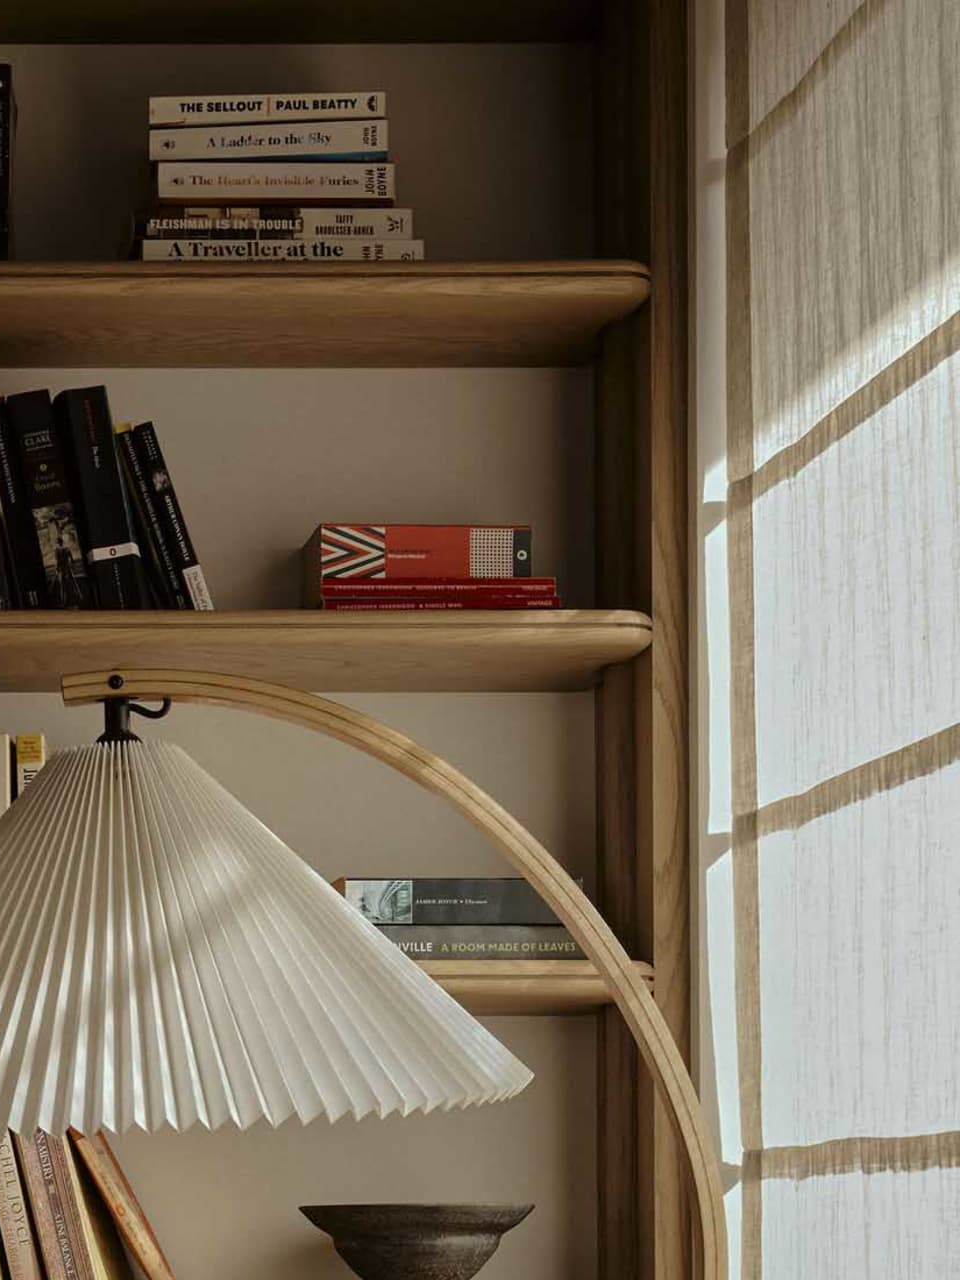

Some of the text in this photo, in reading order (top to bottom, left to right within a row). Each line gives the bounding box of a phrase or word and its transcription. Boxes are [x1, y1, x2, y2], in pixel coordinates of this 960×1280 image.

[180, 98, 358, 114] THE SELLOUT PAUL BEATTY
[206, 131, 333, 150] A Ladder to the Sky
[190, 174, 360, 187] The Furies
[364, 169, 375, 195] JOHN
[376, 166, 387, 197] BOYNE
[150, 216, 303, 231] FLEISHMAN TROUBLE
[189, 241, 345, 258] Traveller at the
[441, 941, 576, 953] A ROOM MADE OF LEAVES
[8, 1191, 29, 1247] JOYCE
